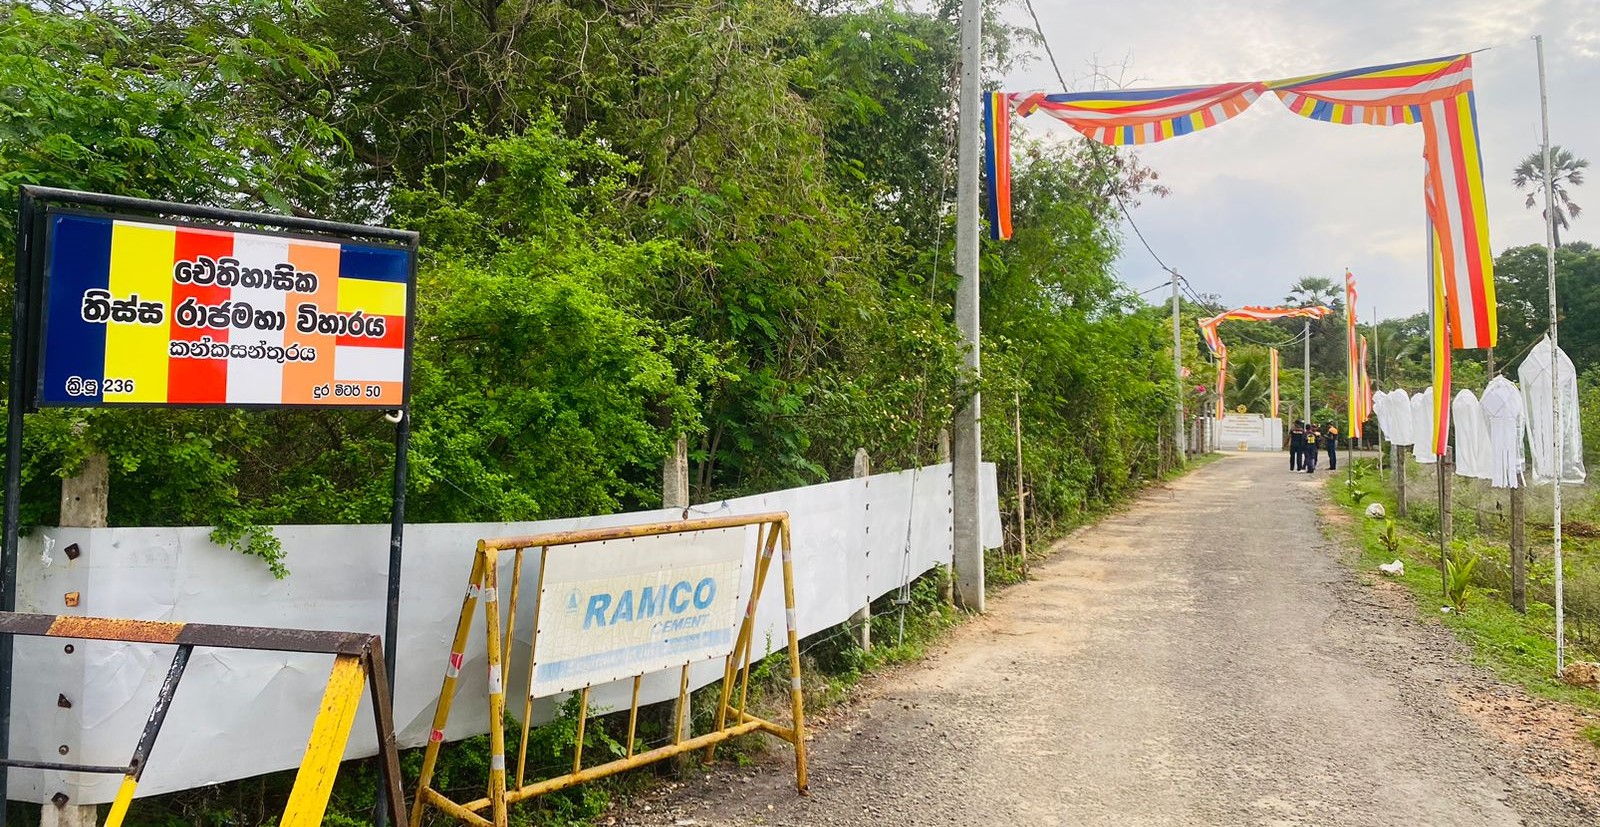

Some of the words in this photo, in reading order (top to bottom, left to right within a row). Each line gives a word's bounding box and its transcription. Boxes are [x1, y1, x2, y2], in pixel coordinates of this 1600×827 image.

[174, 256, 318, 293] ඓතිහාසික
[83, 290, 163, 324] තිස්ස
[176, 298, 286, 331] රාජමහා
[296, 303, 386, 337] විහාරය
[169, 337, 316, 364] කන්කසන්තුරය
[103, 379, 134, 392] 236
[313, 384, 330, 399] දුර
[366, 385, 381, 397] 50
[581, 576, 717, 630] RAMCO
[651, 613, 710, 634] CEMENT
